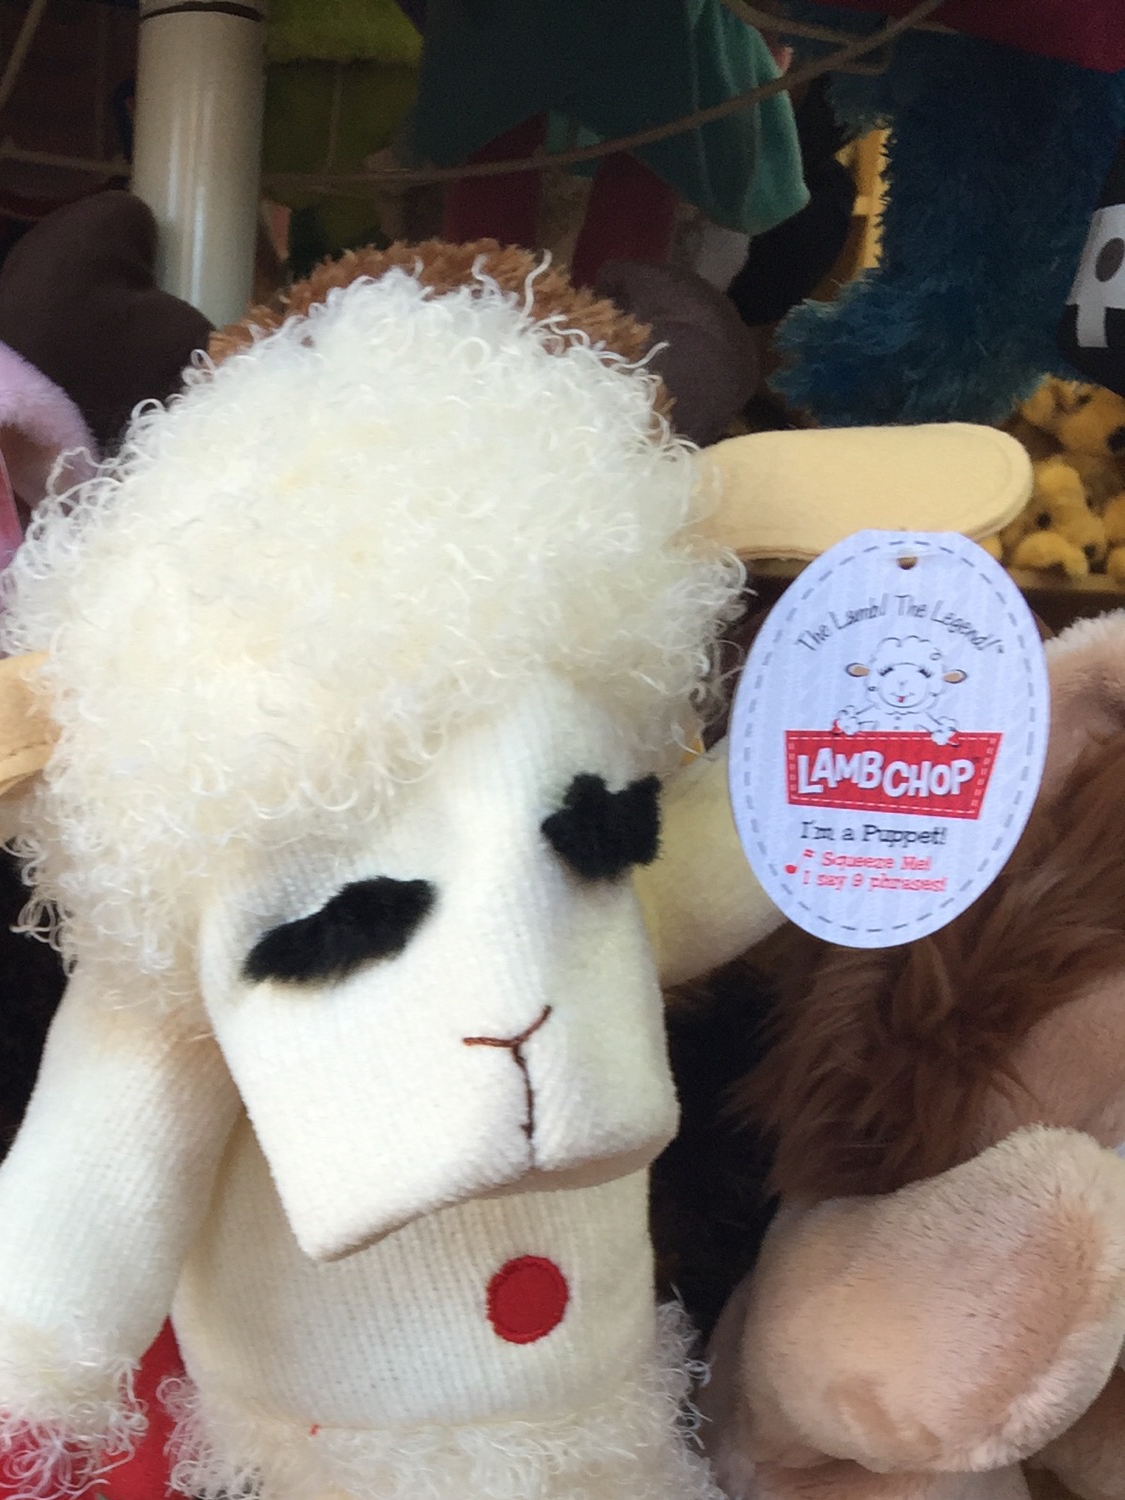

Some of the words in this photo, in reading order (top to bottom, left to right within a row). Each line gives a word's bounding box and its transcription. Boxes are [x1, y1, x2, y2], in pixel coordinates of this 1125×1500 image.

[794, 623, 831, 652] The
[895, 594, 928, 619] The
[800, 820, 835, 841] I'm
[842, 827, 855, 842] a
[861, 824, 948, 848] Puppet!
[821, 851, 895, 871] Squeeze
[900, 855, 932, 872] Me!
[816, 873, 847, 890] say
[868, 874, 948, 892] phrases!
